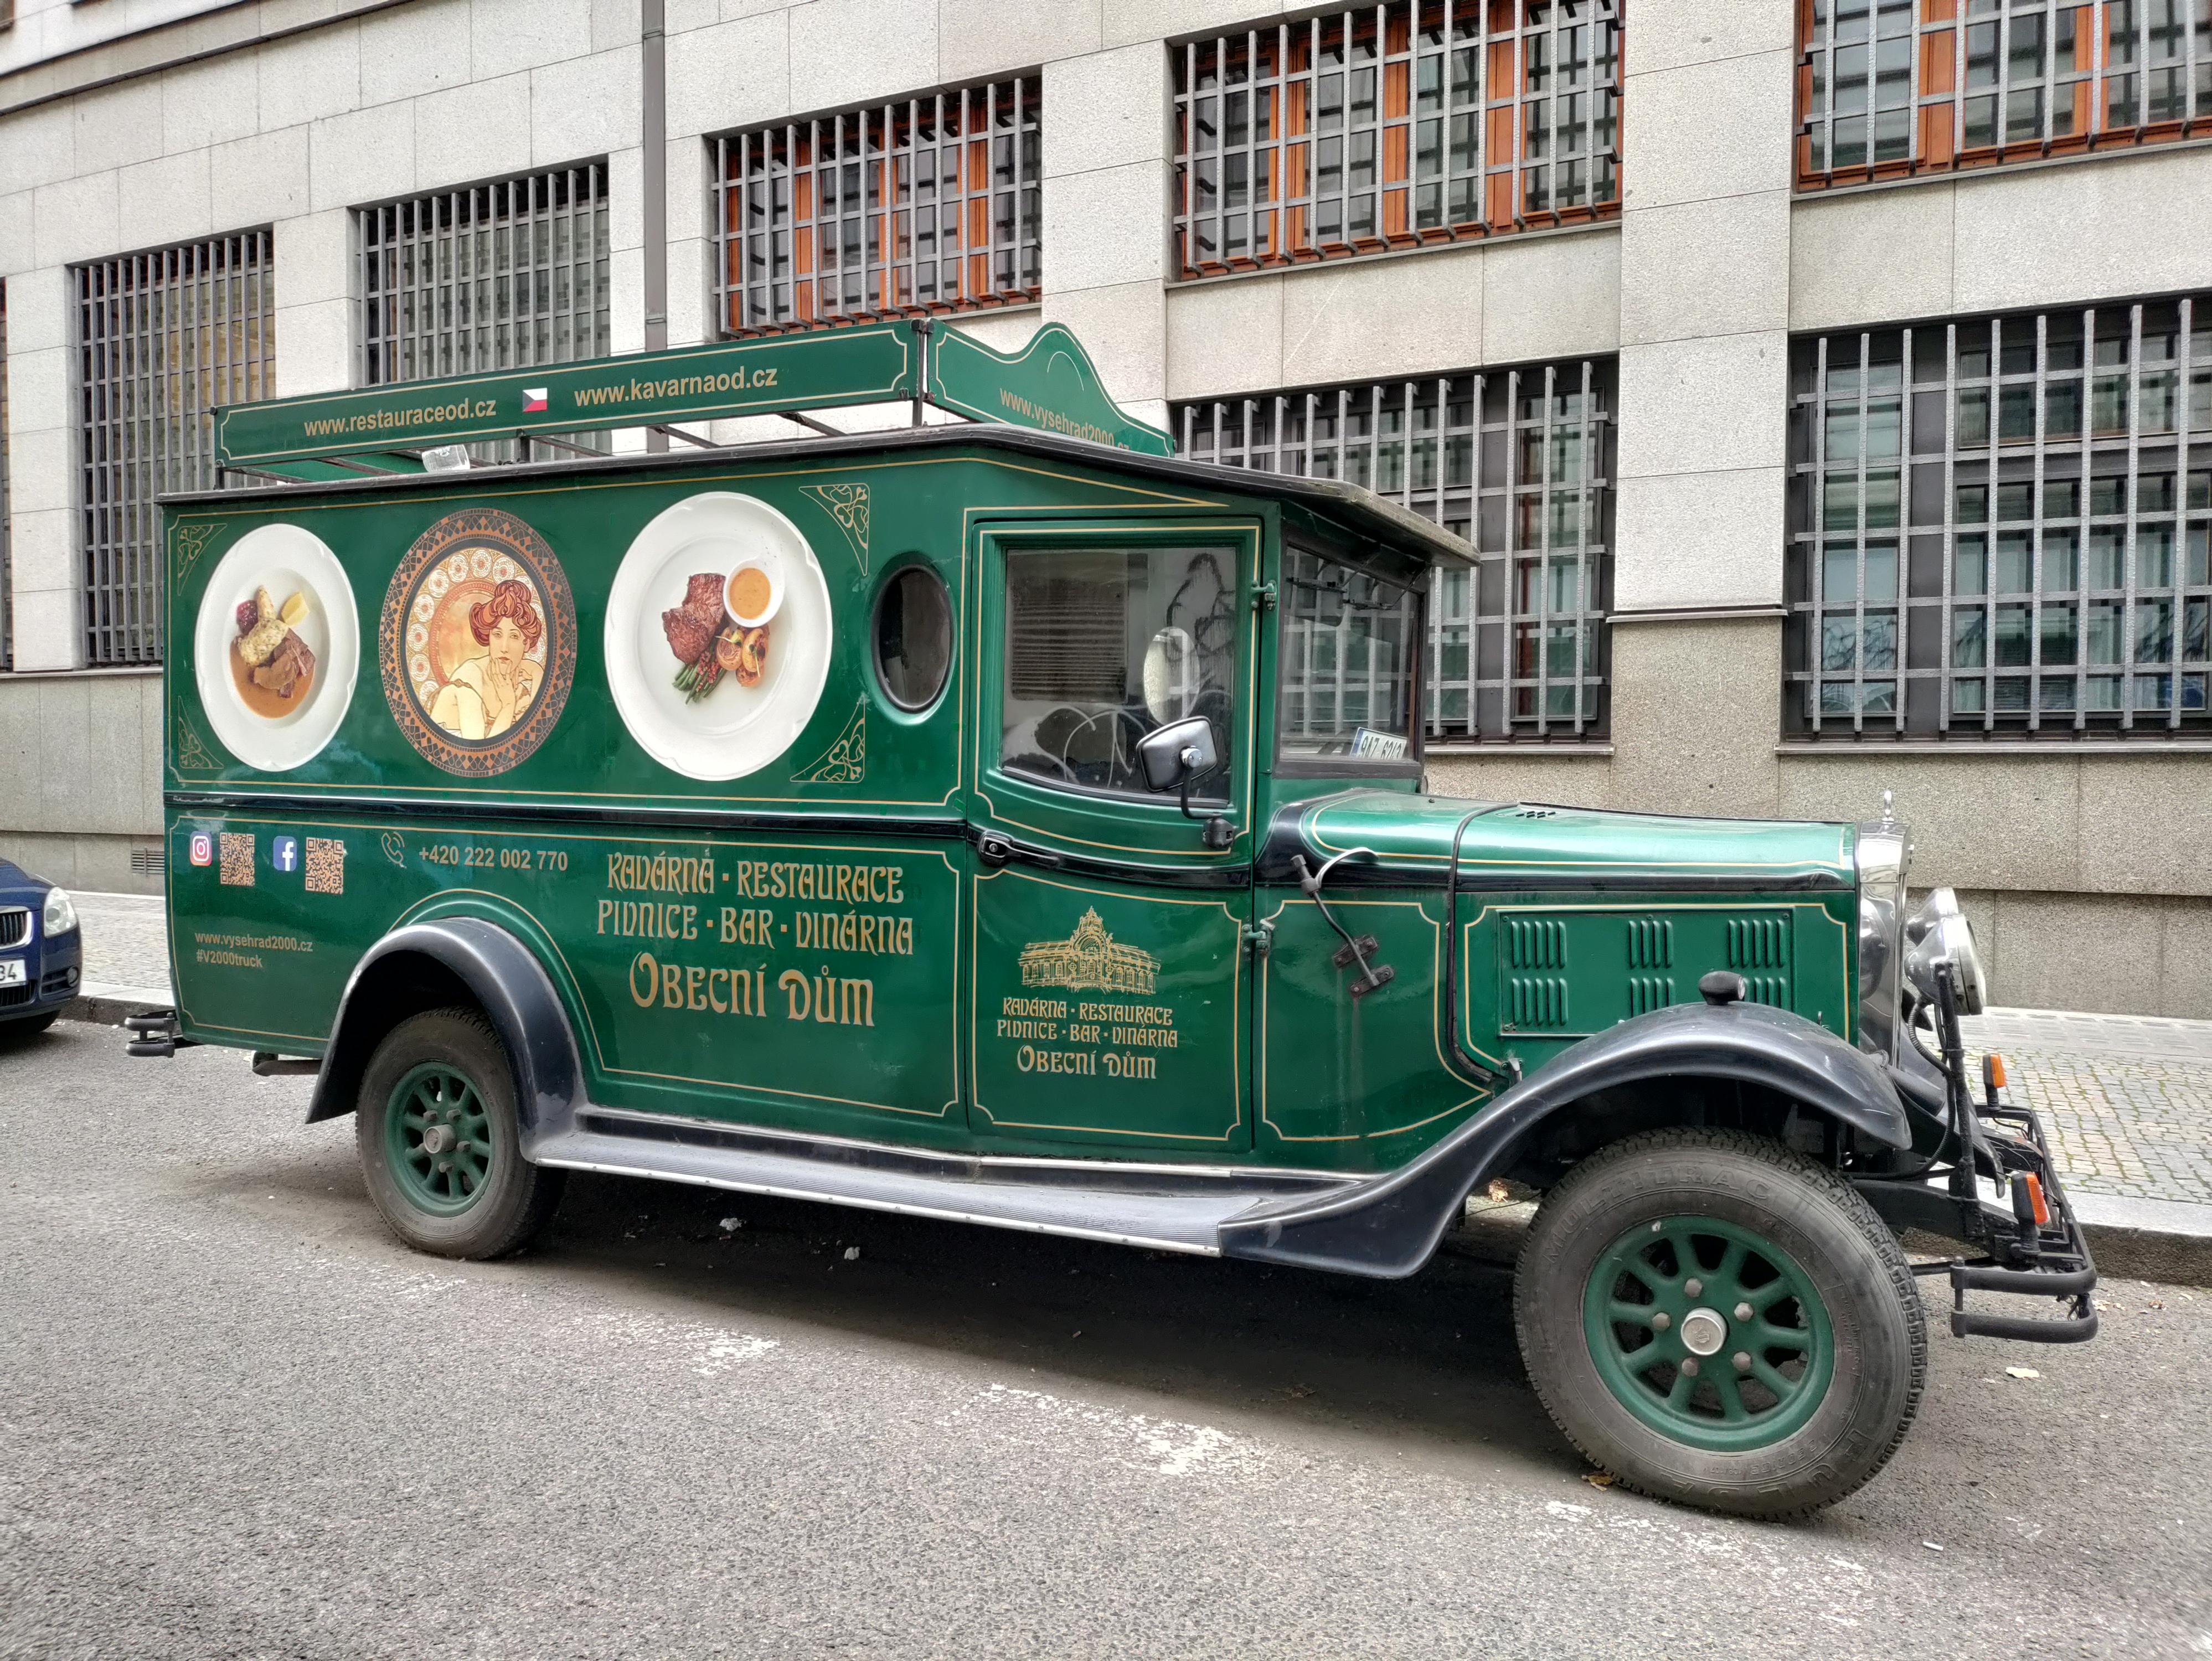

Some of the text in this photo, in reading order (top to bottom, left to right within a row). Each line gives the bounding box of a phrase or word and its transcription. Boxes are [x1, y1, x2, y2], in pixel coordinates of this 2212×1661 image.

[574, 366, 777, 406] www.kavarnaod.cz
[304, 398, 497, 436] www.restauraceod.cz
[999, 388, 1130, 451] www.vysehrad2000
[419, 845, 568, 871] +420 222 002 770
[607, 851, 904, 905] KAVÁRNA RESTAURACE
[195, 932, 313, 952] www.vysehrad2000.cz
[596, 900, 913, 956] PIVNICE BAR VINÁRNA
[196, 949, 263, 968] #V2000truck
[1003, 997, 1173, 1026] KAVÁRNA RESTAURACE
[997, 1020, 1178, 1048] PIVNICE BAR VINÁRNA
